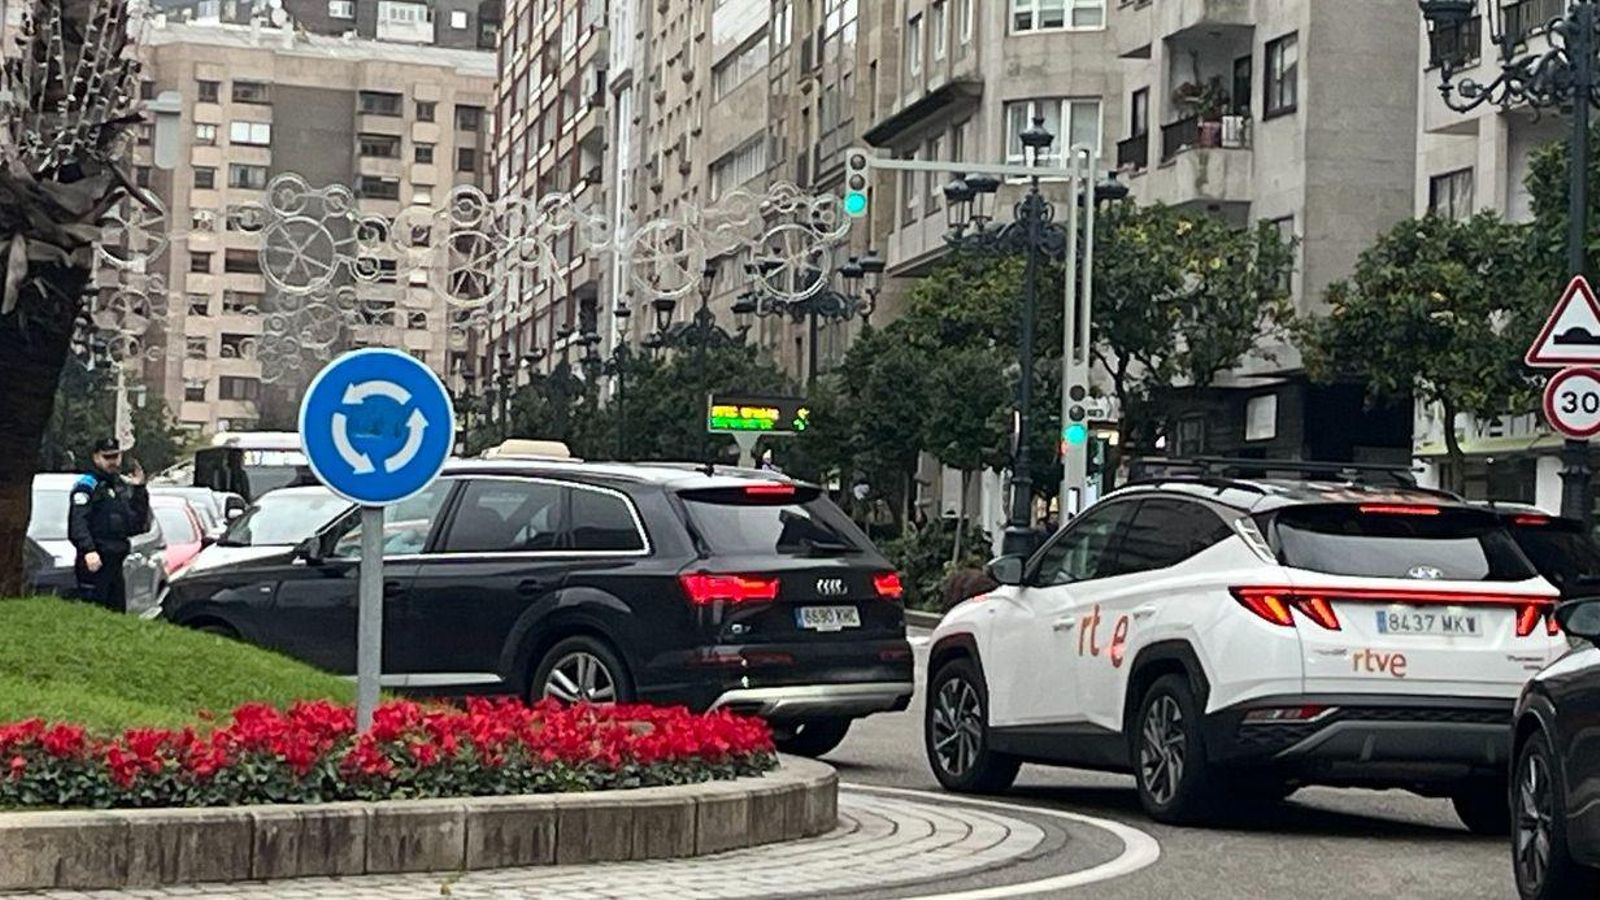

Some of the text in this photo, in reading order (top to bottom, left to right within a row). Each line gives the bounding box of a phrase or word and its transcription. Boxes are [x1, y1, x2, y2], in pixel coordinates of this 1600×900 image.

[1561, 391, 1599, 414] 30
[1388, 613, 1435, 631] 8437
[1353, 648, 1407, 678] rtve
